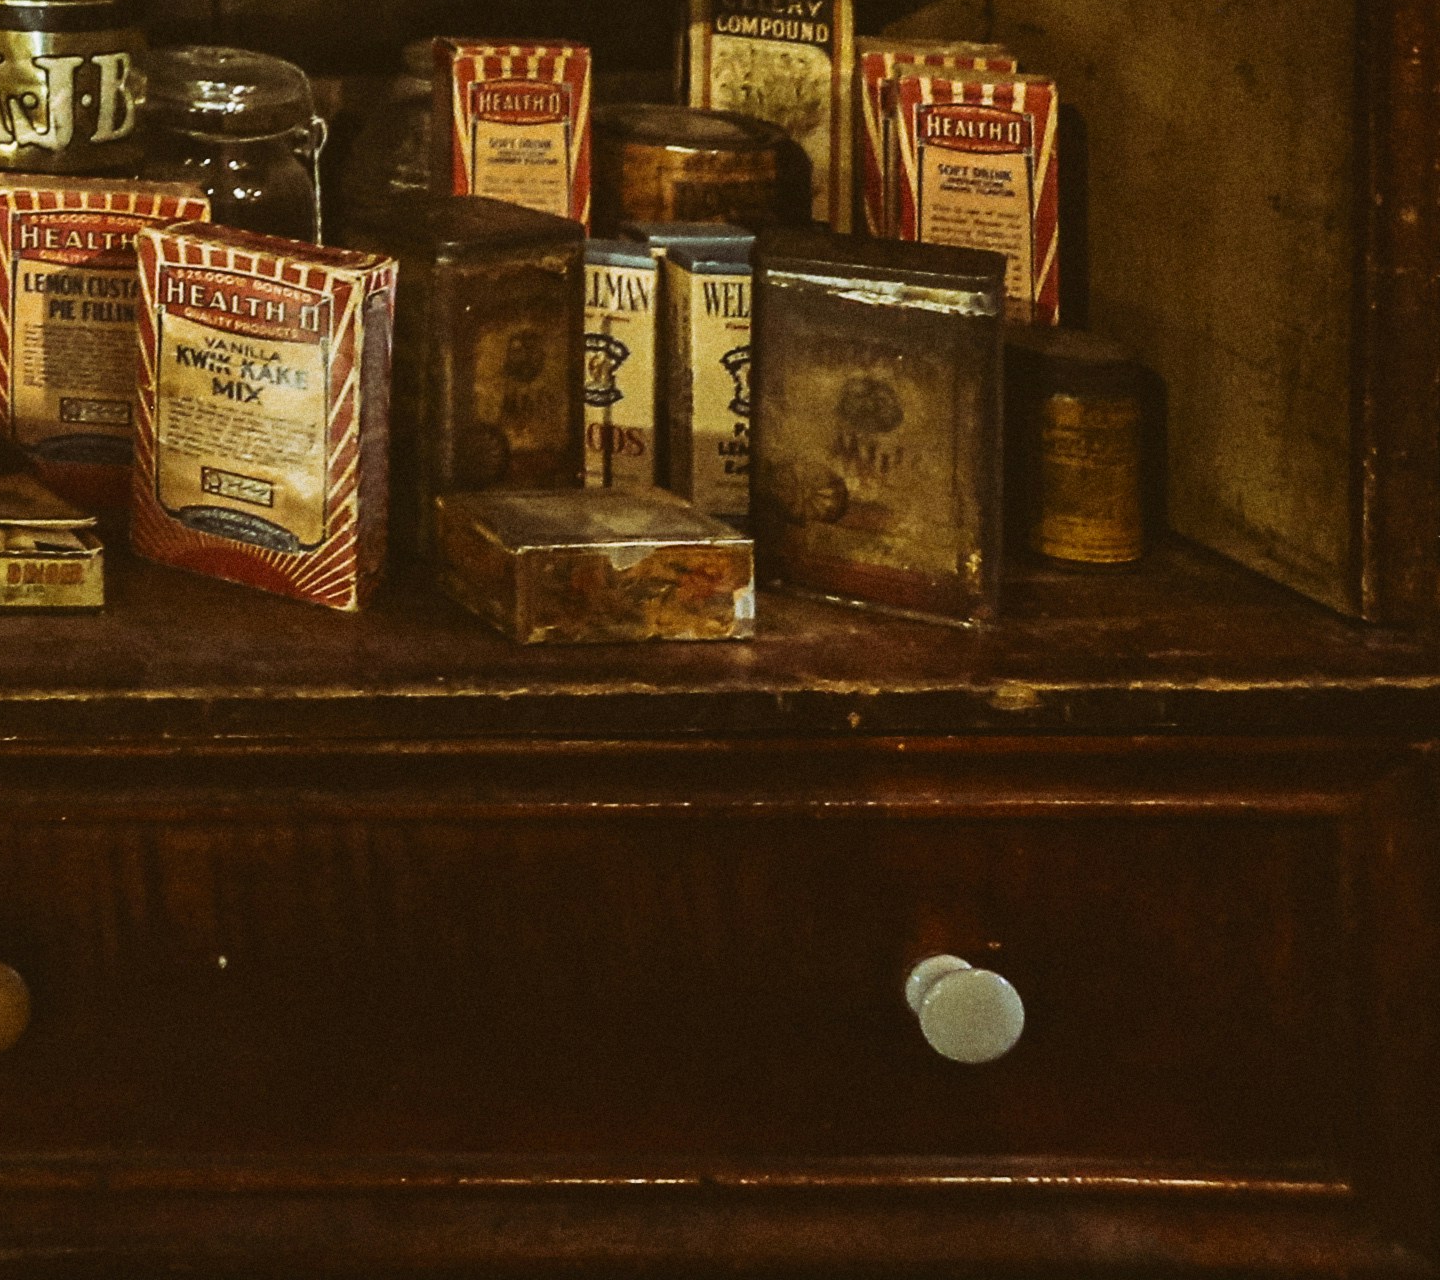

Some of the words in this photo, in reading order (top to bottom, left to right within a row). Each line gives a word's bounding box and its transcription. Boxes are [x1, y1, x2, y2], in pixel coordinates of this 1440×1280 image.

[716, 16, 830, 43] COMPOUND
[203, 336, 281, 362] VANILLA
[241, 358, 309, 390] KAKE
[211, 381, 263, 405] MIX
